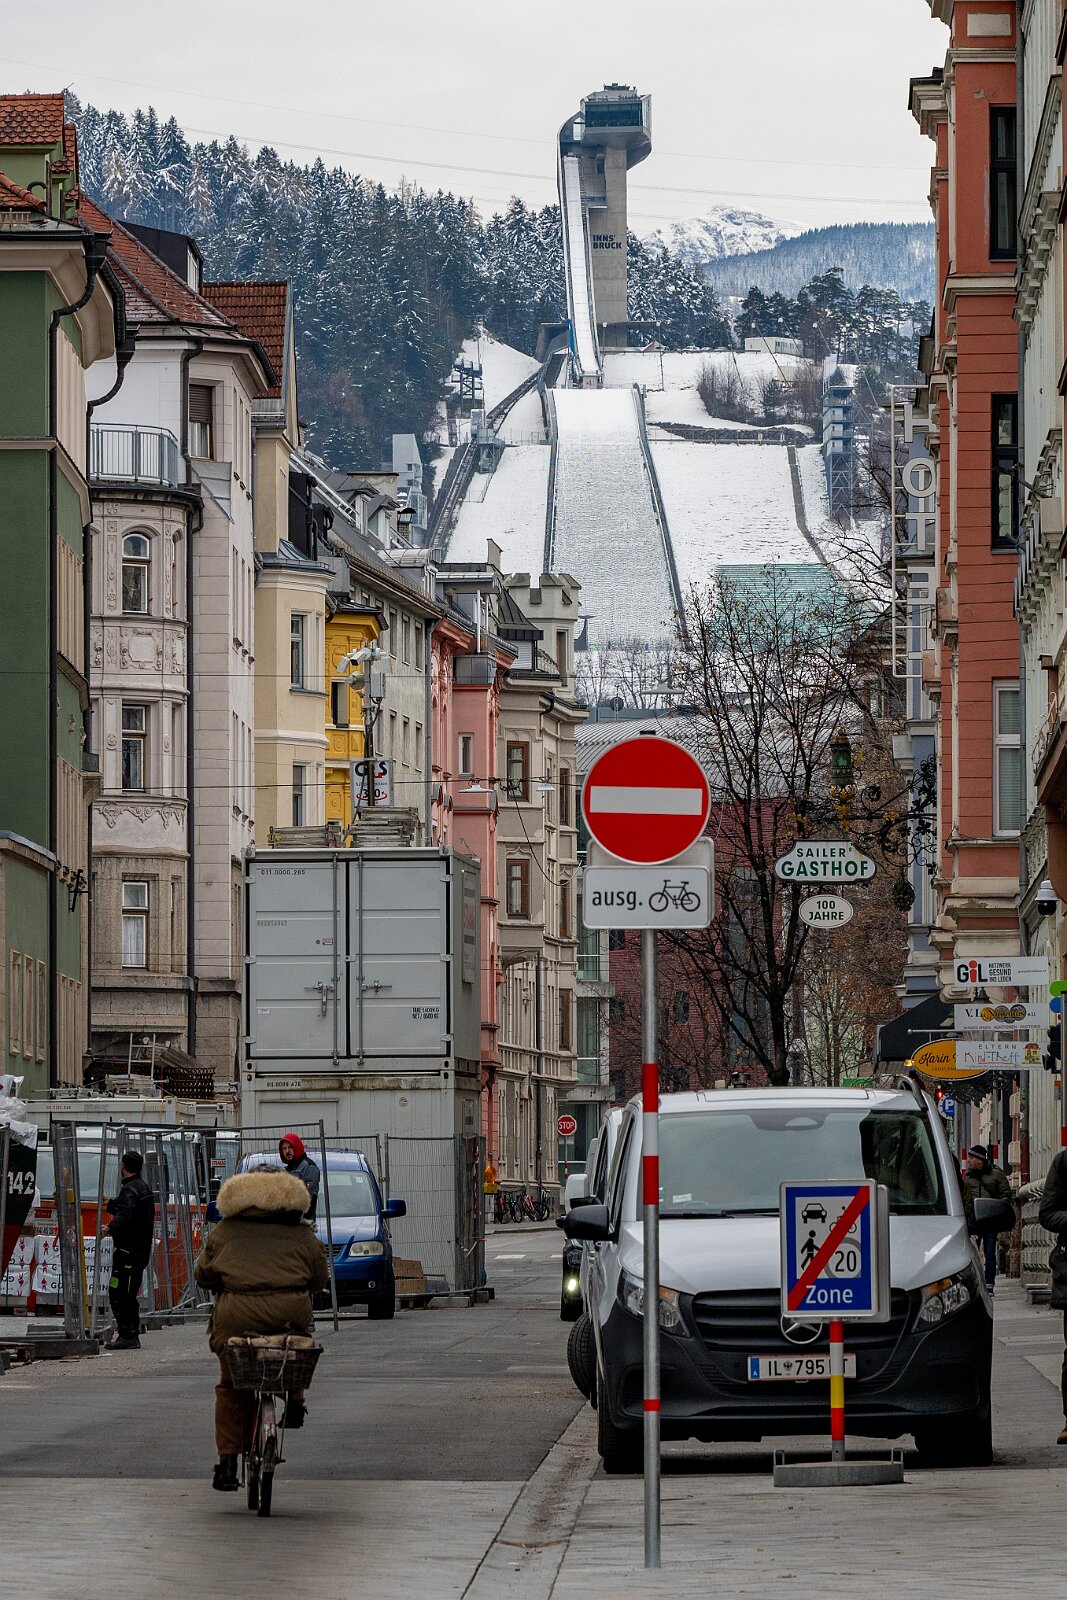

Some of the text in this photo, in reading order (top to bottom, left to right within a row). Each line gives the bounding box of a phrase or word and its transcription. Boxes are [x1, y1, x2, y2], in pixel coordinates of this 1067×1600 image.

[362, 789, 381, 798] 30
[781, 861, 869, 877] GASTHOF
[592, 891, 643, 911] ausg.
[816, 900, 836, 910] 100
[808, 912, 844, 921] JAHRE
[919, 1052, 950, 1066] Karin
[559, 1121, 575, 1130] STOP
[835, 1250, 857, 1273] 20
[805, 1285, 854, 1305] Zone
[768, 1360, 783, 1377] IL
